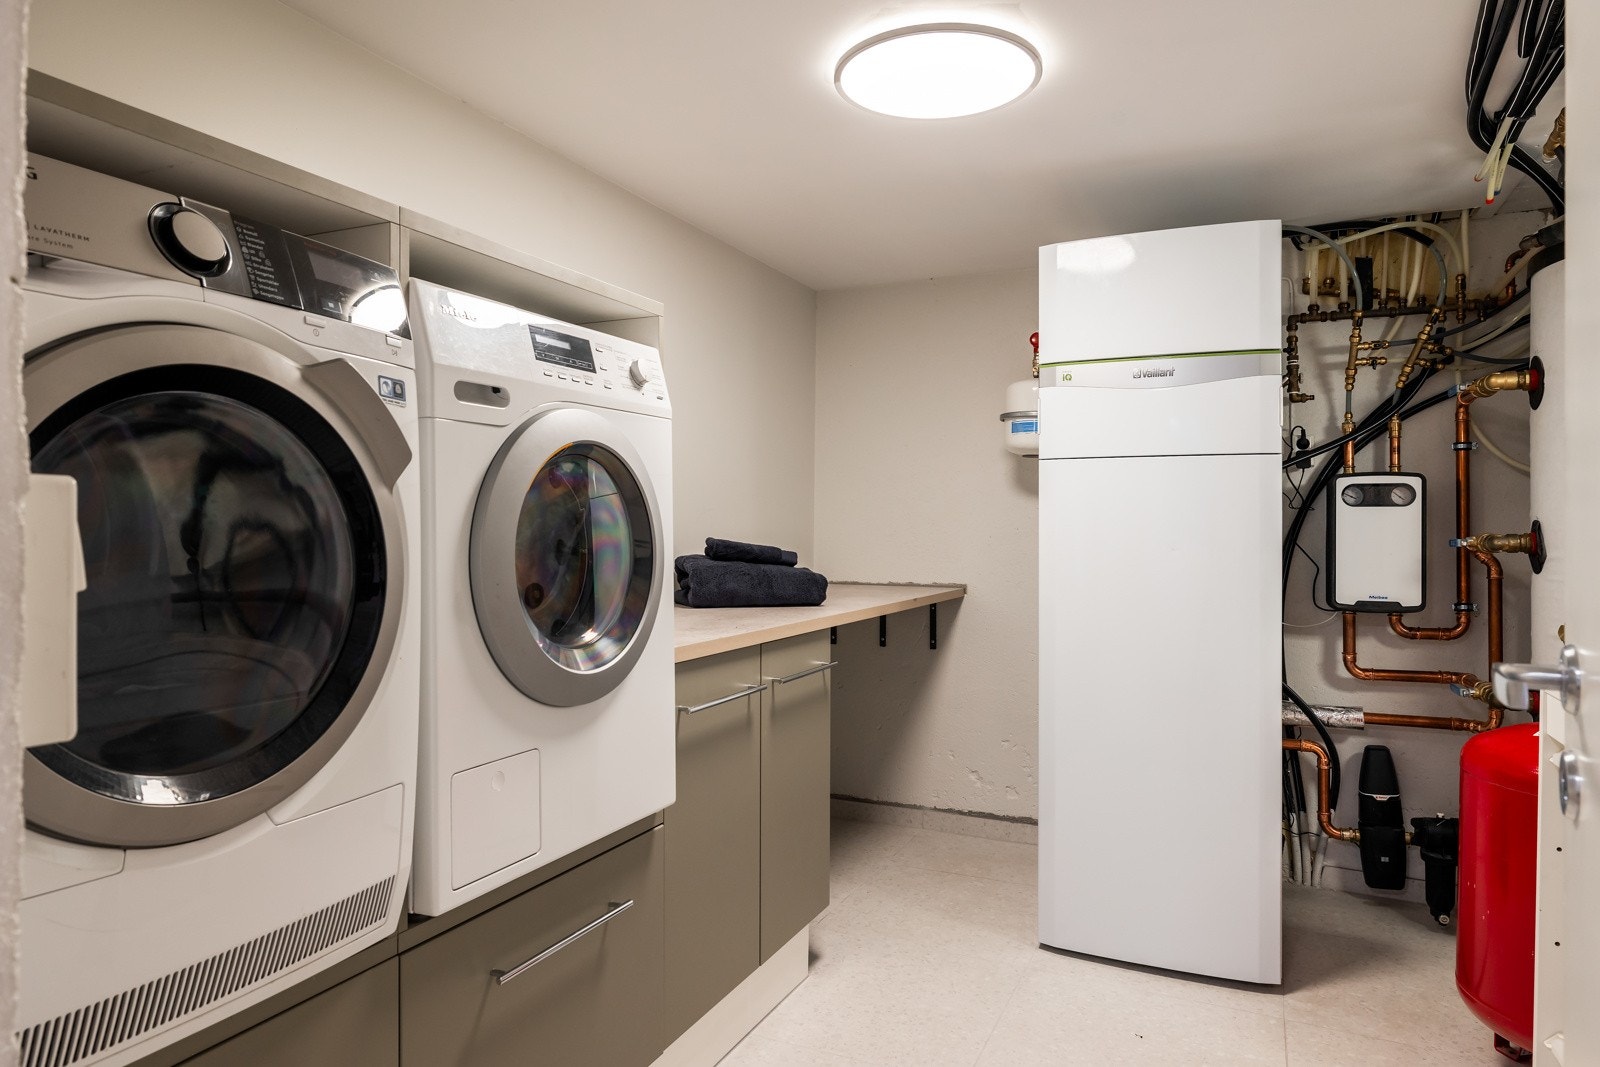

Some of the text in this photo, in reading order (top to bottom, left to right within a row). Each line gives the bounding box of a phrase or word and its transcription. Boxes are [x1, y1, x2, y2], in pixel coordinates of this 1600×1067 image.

[34, 224, 90, 242] LAVATHERM
[43, 238, 74, 249] System
[1142, 366, 1175, 378] Vaillant
